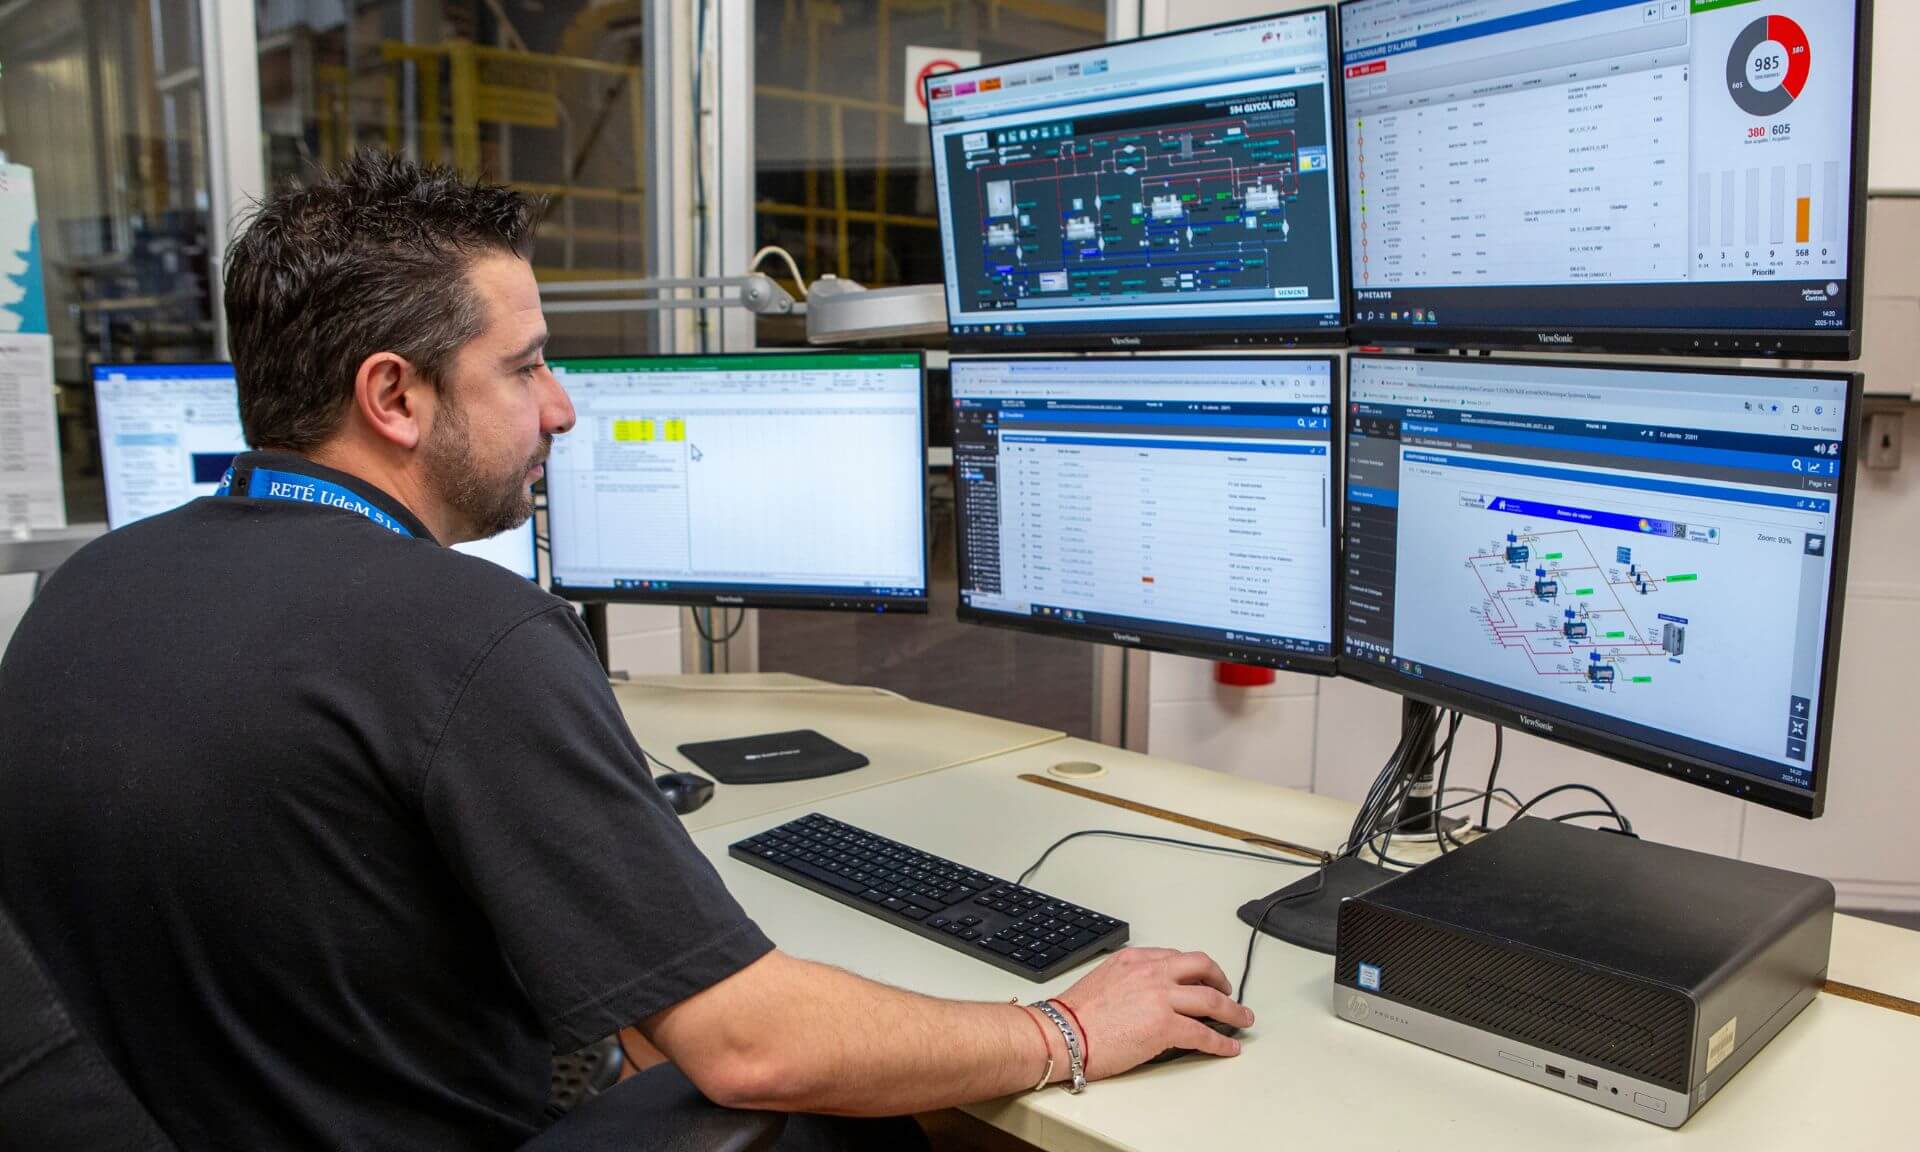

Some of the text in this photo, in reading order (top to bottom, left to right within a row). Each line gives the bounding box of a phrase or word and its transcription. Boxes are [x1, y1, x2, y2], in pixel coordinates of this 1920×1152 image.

[1792, 46, 1804, 54] 380
[1754, 55, 1780, 72] 985
[1732, 81, 1744, 90] 605
[1244, 101, 1271, 112] GLYCOL
[1272, 98, 1296, 109] FROID
[1747, 126, 1766, 138] 380
[1772, 123, 1791, 136] 605
[1769, 250, 1774, 258] 9
[1795, 249, 1809, 257] 568
[1821, 248, 1827, 256] 0
[1752, 268, 1776, 277] Priorité
[1278, 288, 1305, 297] SIEMENS
[1363, 290, 1392, 299] METASYS
[1801, 288, 1824, 296] Johnson
[1805, 294, 1828, 302] Controls
[1538, 333, 1574, 344] ViewSonic
[1808, 479, 1823, 488] Page
[269, 482, 315, 502] RETÉ
[320, 491, 370, 517] UdeM
[1757, 533, 1792, 545] Zoom: 93%
[1519, 714, 1554, 731] ViewSonic
